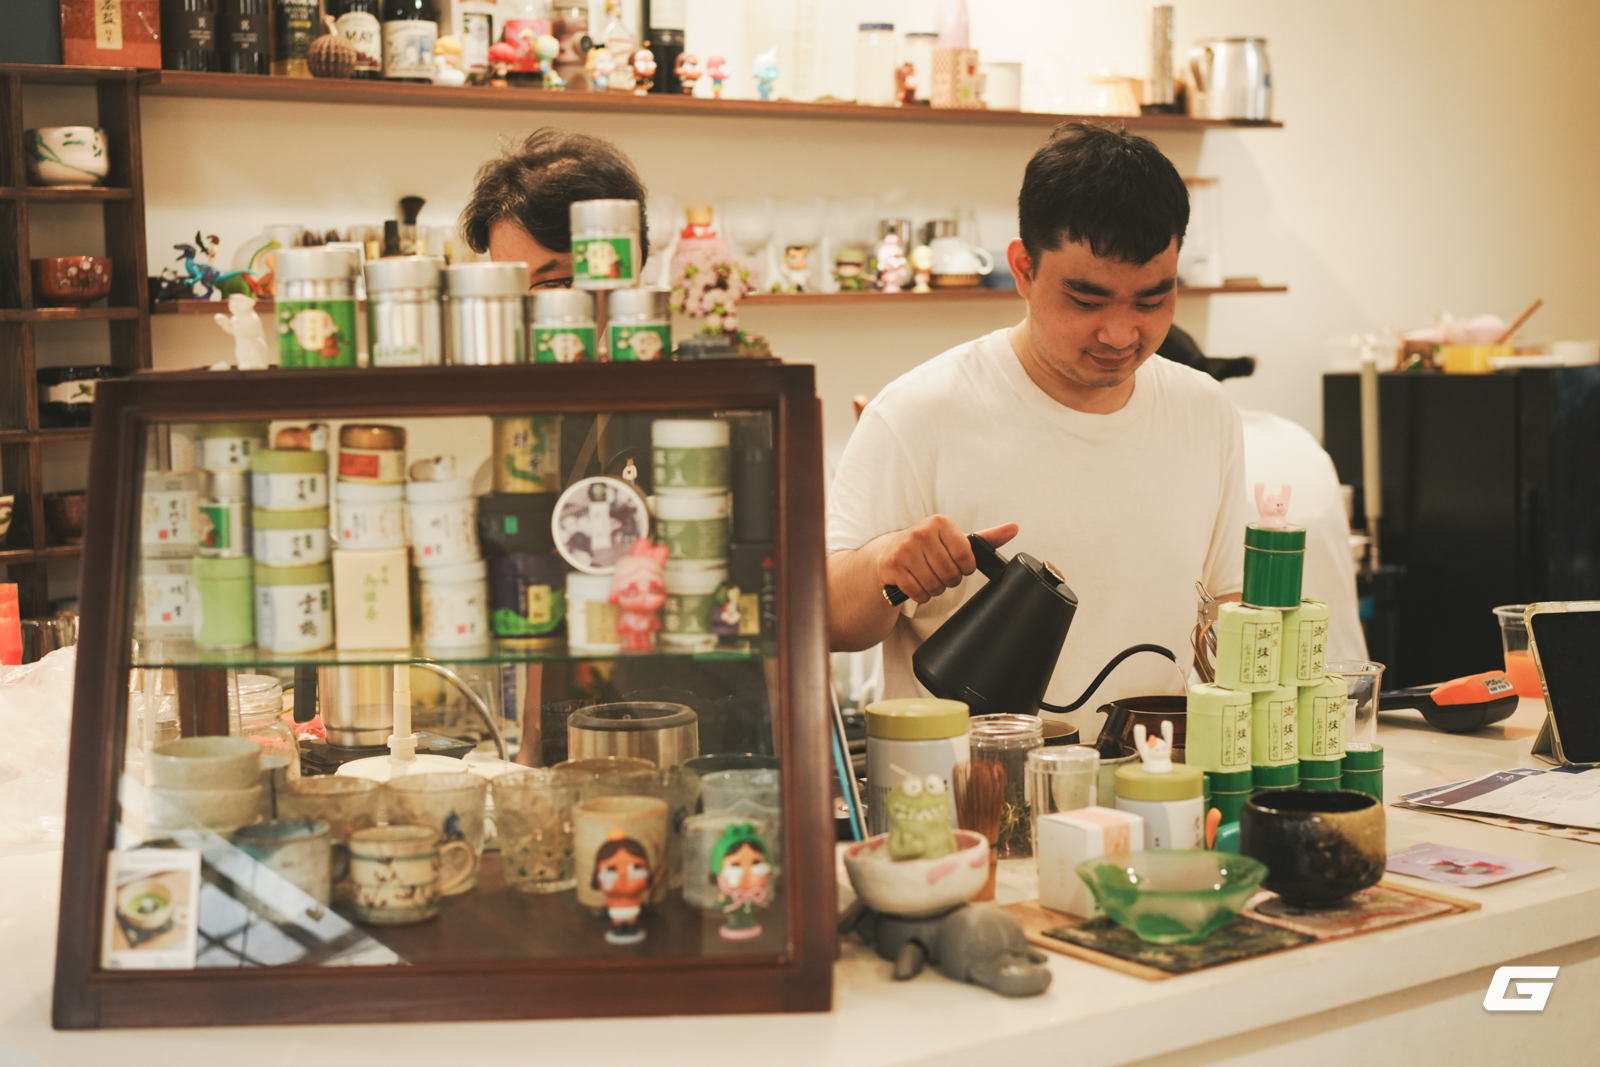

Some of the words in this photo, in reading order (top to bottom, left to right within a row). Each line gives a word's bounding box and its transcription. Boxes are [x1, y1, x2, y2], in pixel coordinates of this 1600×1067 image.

[1256, 628, 1271, 678] 御抹茶
[1327, 702, 1340, 750] 御抹茶
